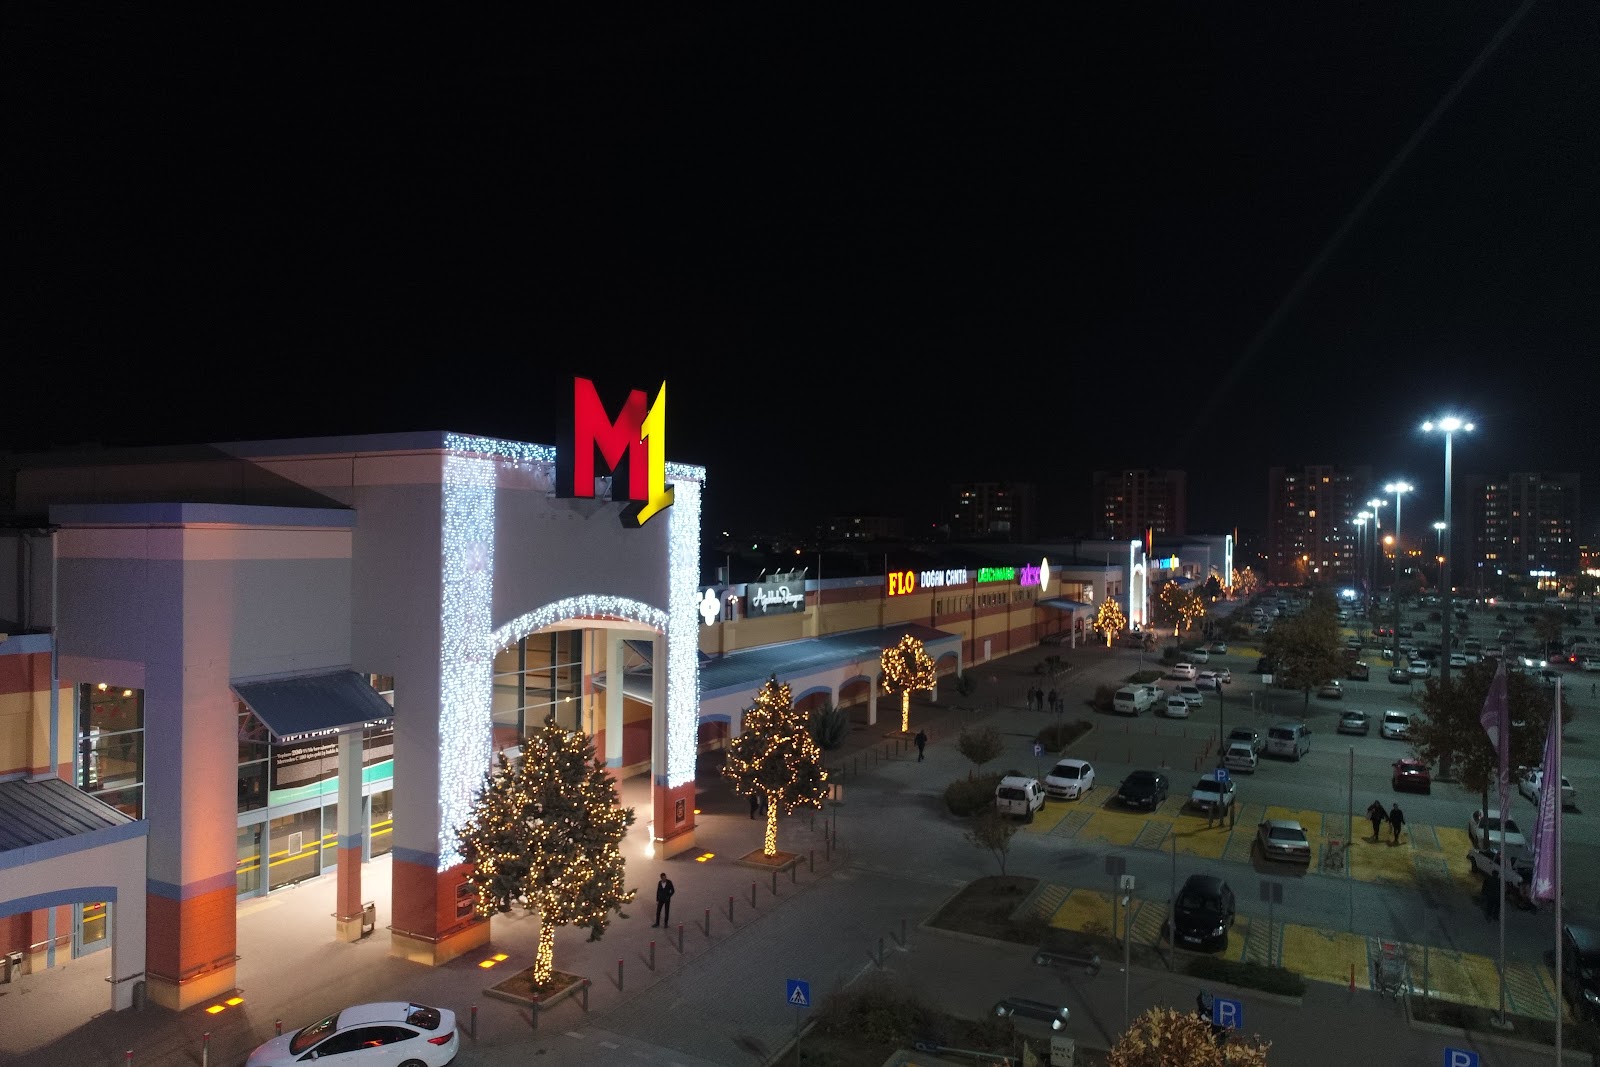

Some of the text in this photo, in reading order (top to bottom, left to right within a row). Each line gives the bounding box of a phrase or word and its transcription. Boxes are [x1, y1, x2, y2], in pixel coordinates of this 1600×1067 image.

[574, 376, 675, 526] M1
[888, 570, 915, 596] FLO
[1217, 769, 1226, 781] P
